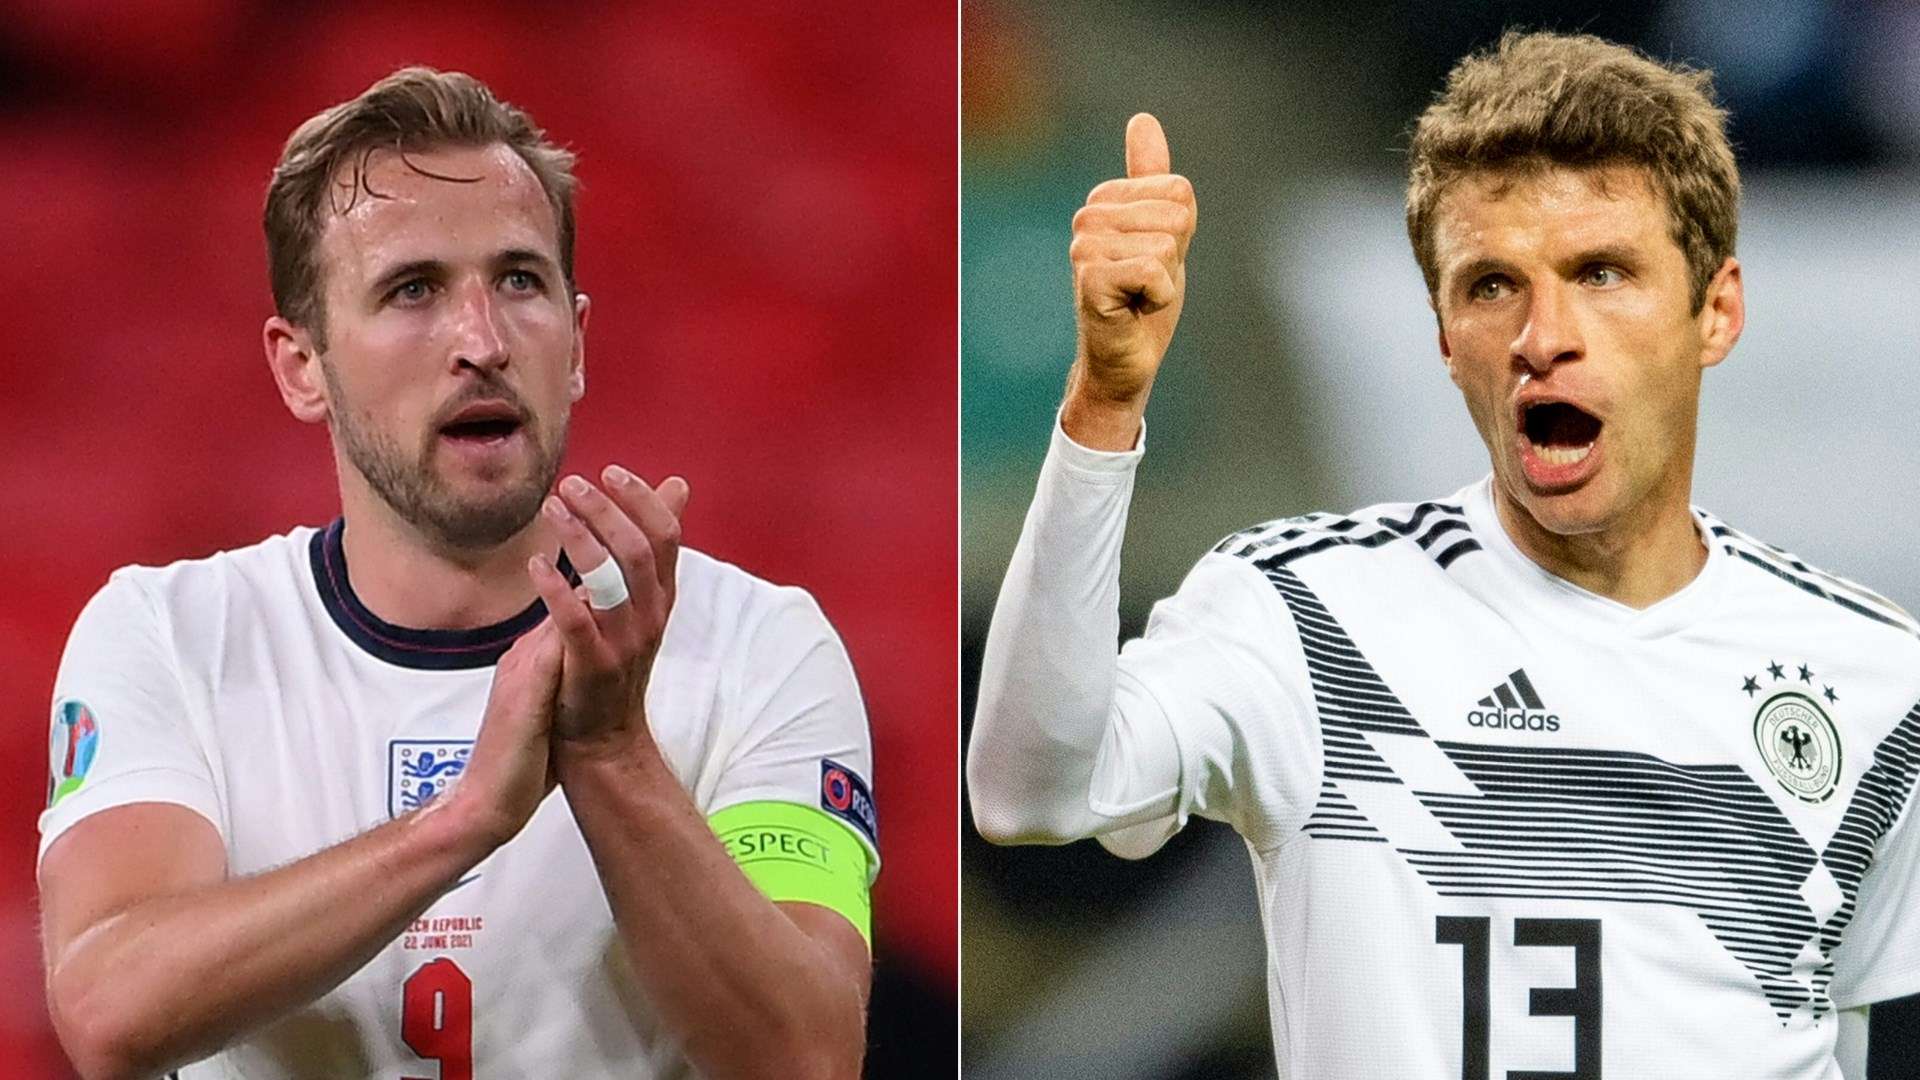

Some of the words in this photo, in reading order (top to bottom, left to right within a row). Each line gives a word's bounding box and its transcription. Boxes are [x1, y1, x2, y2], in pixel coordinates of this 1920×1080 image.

[1467, 708, 1560, 732] adidas
[432, 917, 482, 932] REPUBLIC
[404, 936, 418, 949] 22
[421, 935, 448, 949] JUNE
[450, 934, 473, 949] 2021
[1436, 916, 1602, 1080] 13
[402, 957, 473, 1080] 9
